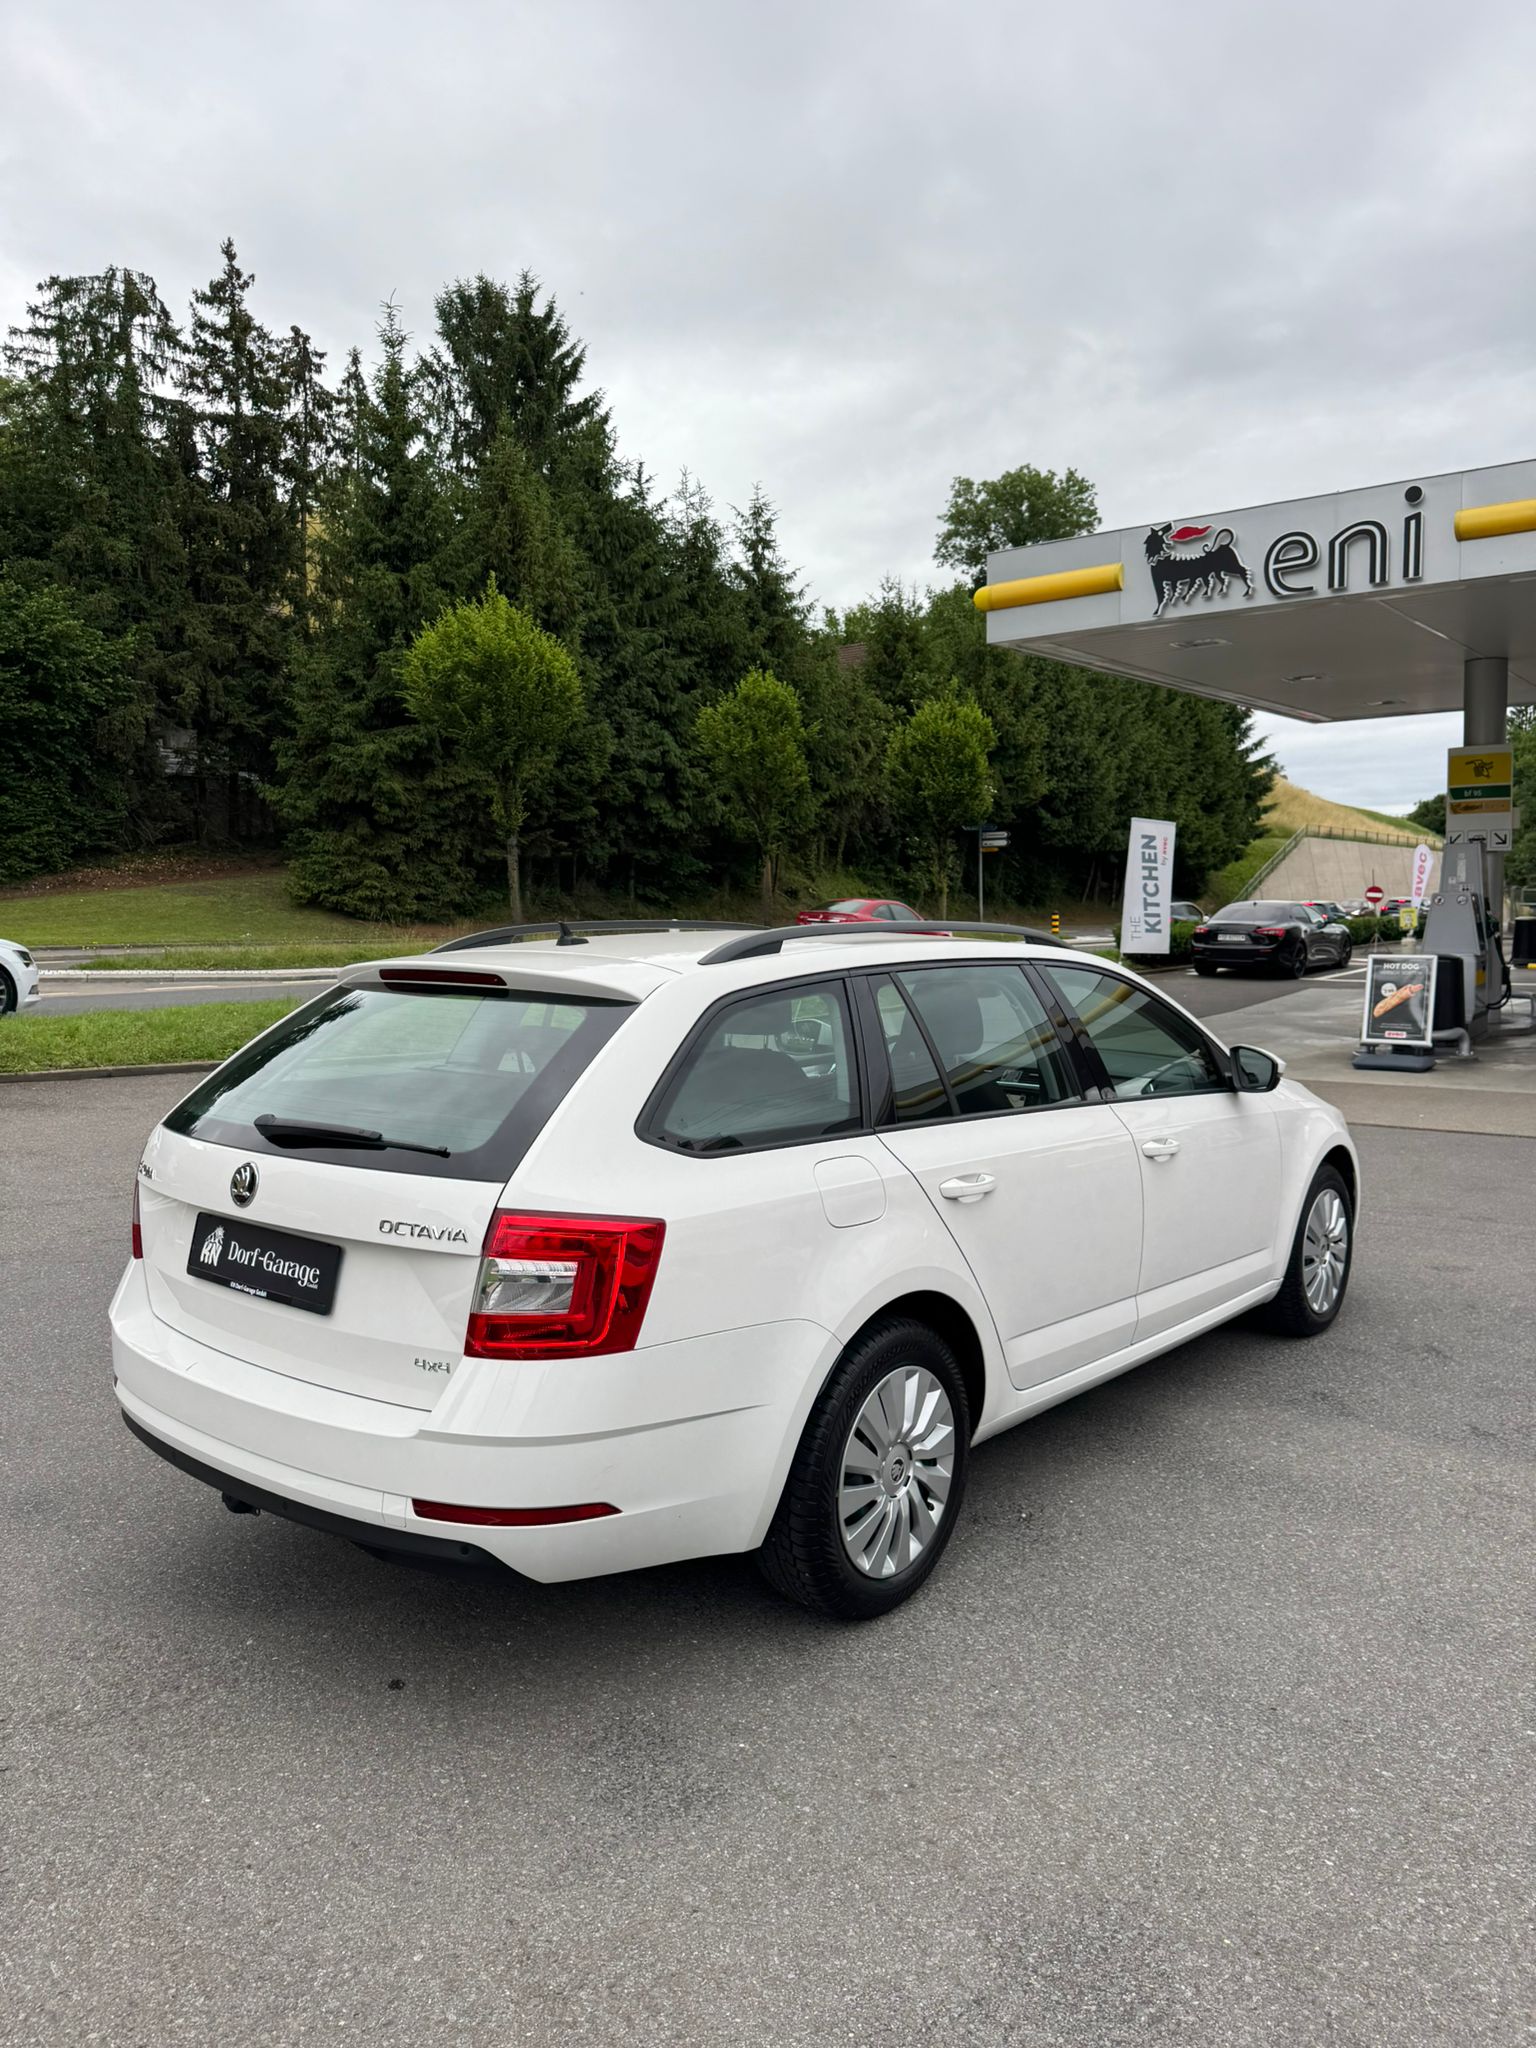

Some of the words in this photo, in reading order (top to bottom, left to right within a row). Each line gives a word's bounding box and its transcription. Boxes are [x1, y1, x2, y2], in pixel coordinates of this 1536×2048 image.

[1263, 485, 1424, 597] eni
[1141, 834, 1162, 934] KITCHEN
[1414, 852, 1427, 897] avec
[1130, 915, 1142, 941] THE
[379, 1219, 469, 1244] OCTAVIA
[227, 1240, 321, 1287] Dorf-Garage
